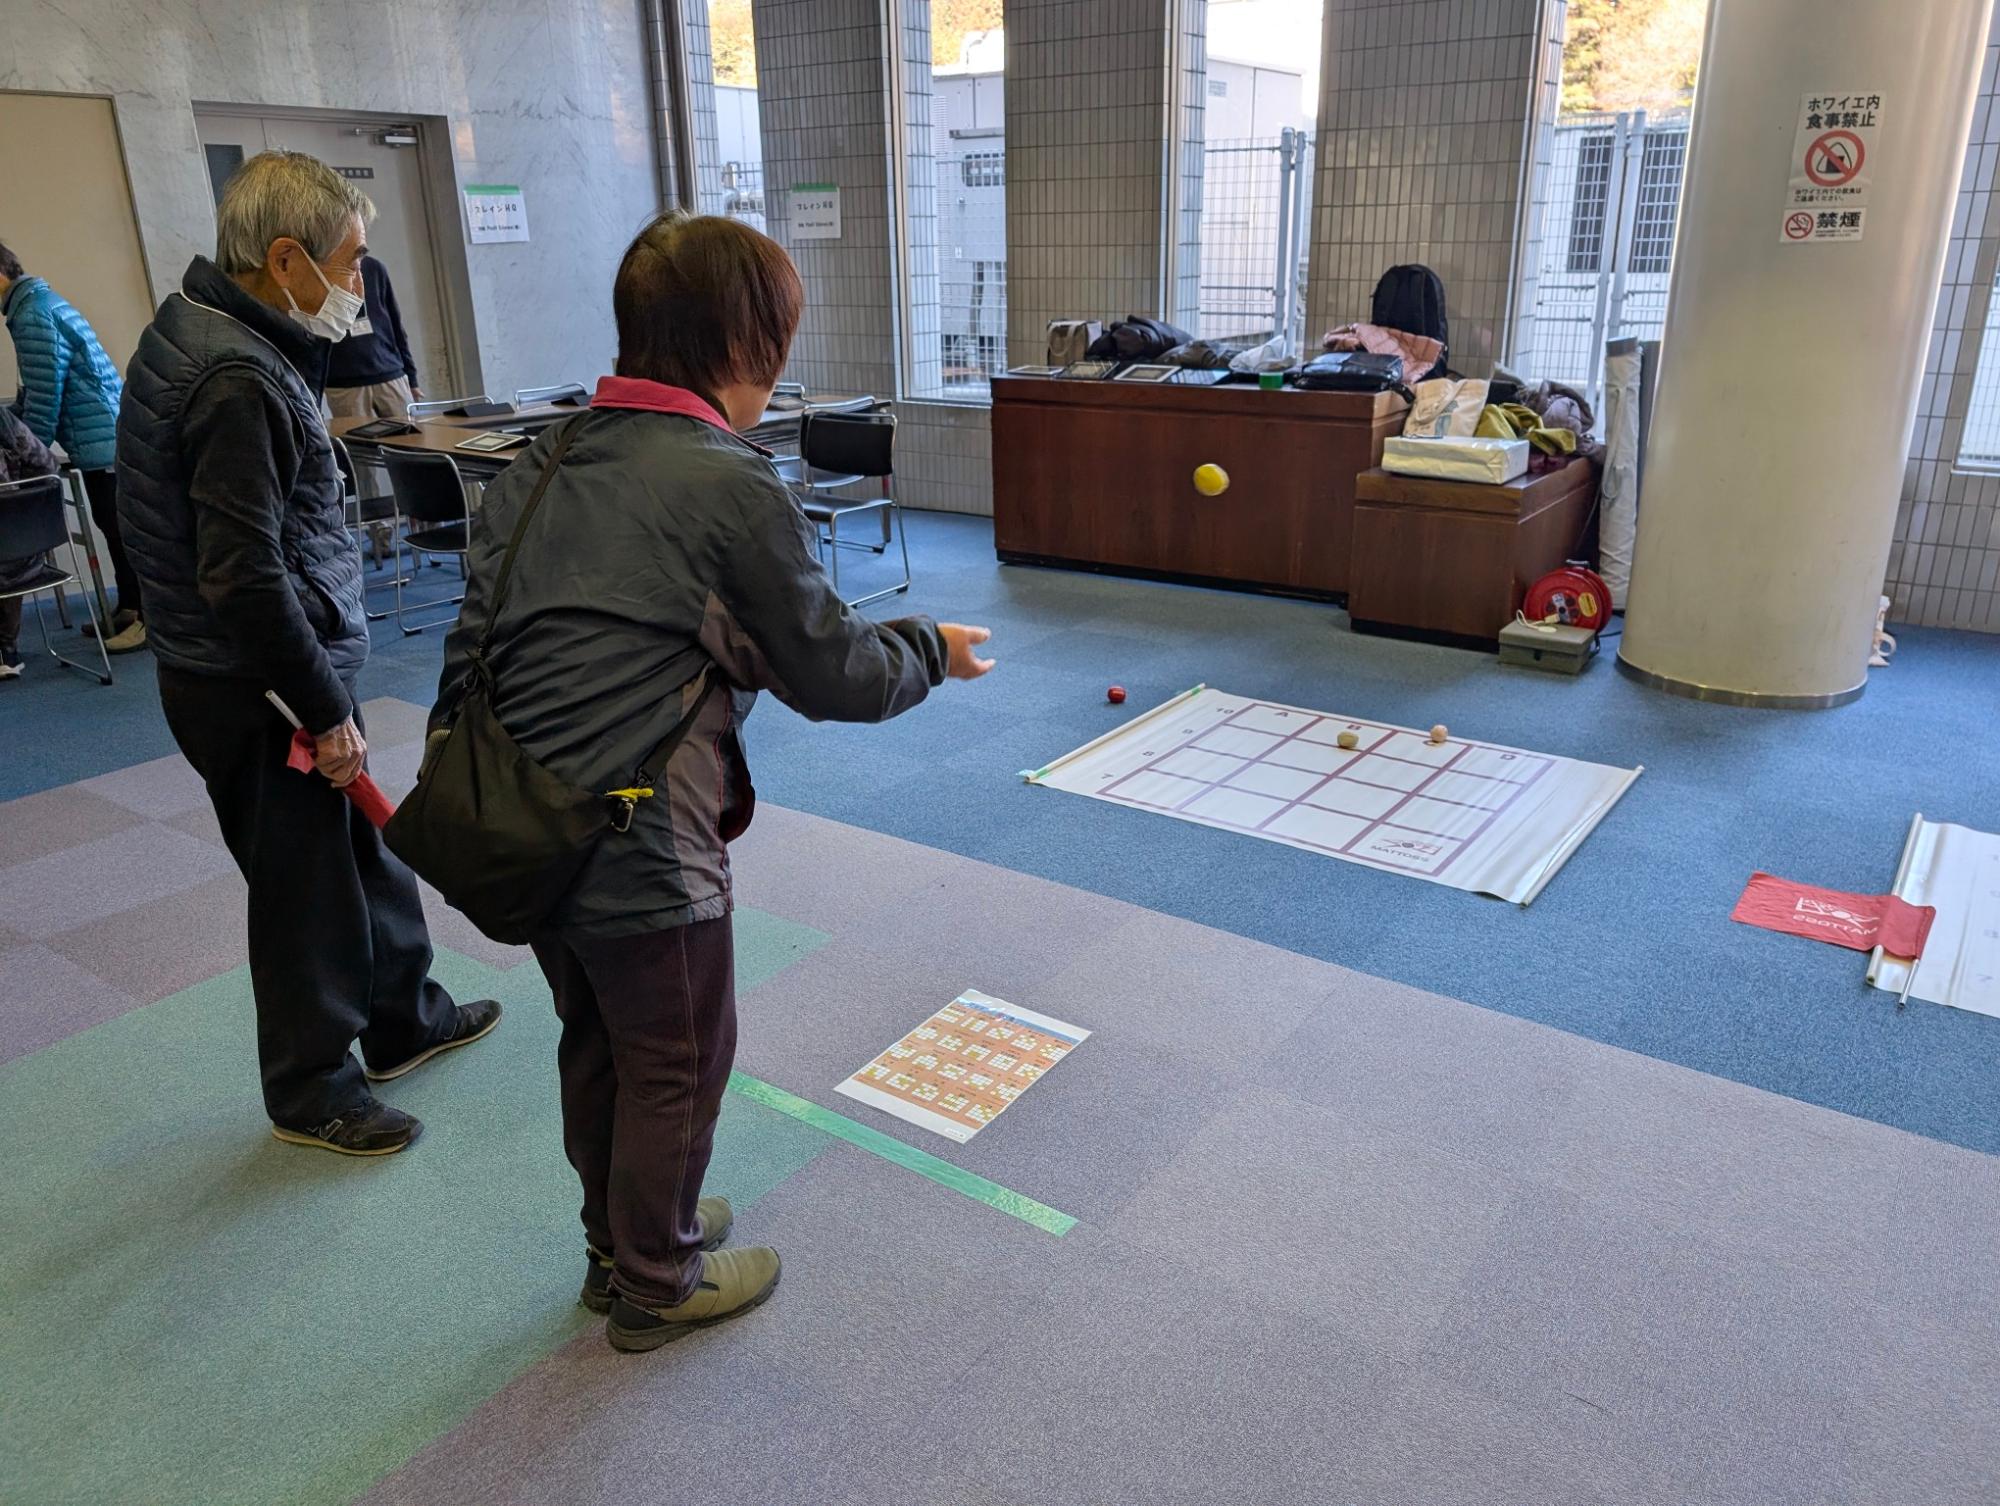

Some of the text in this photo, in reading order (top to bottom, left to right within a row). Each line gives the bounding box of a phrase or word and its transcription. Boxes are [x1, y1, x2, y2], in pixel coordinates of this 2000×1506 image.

[1807, 94, 1881, 112] ホワイエ内
[1805, 111, 1876, 130] 食事禁止
[1816, 211, 1862, 229] 禁煙
[1499, 753, 1516, 761] D
[1370, 845, 1430, 863] MATTOSS
